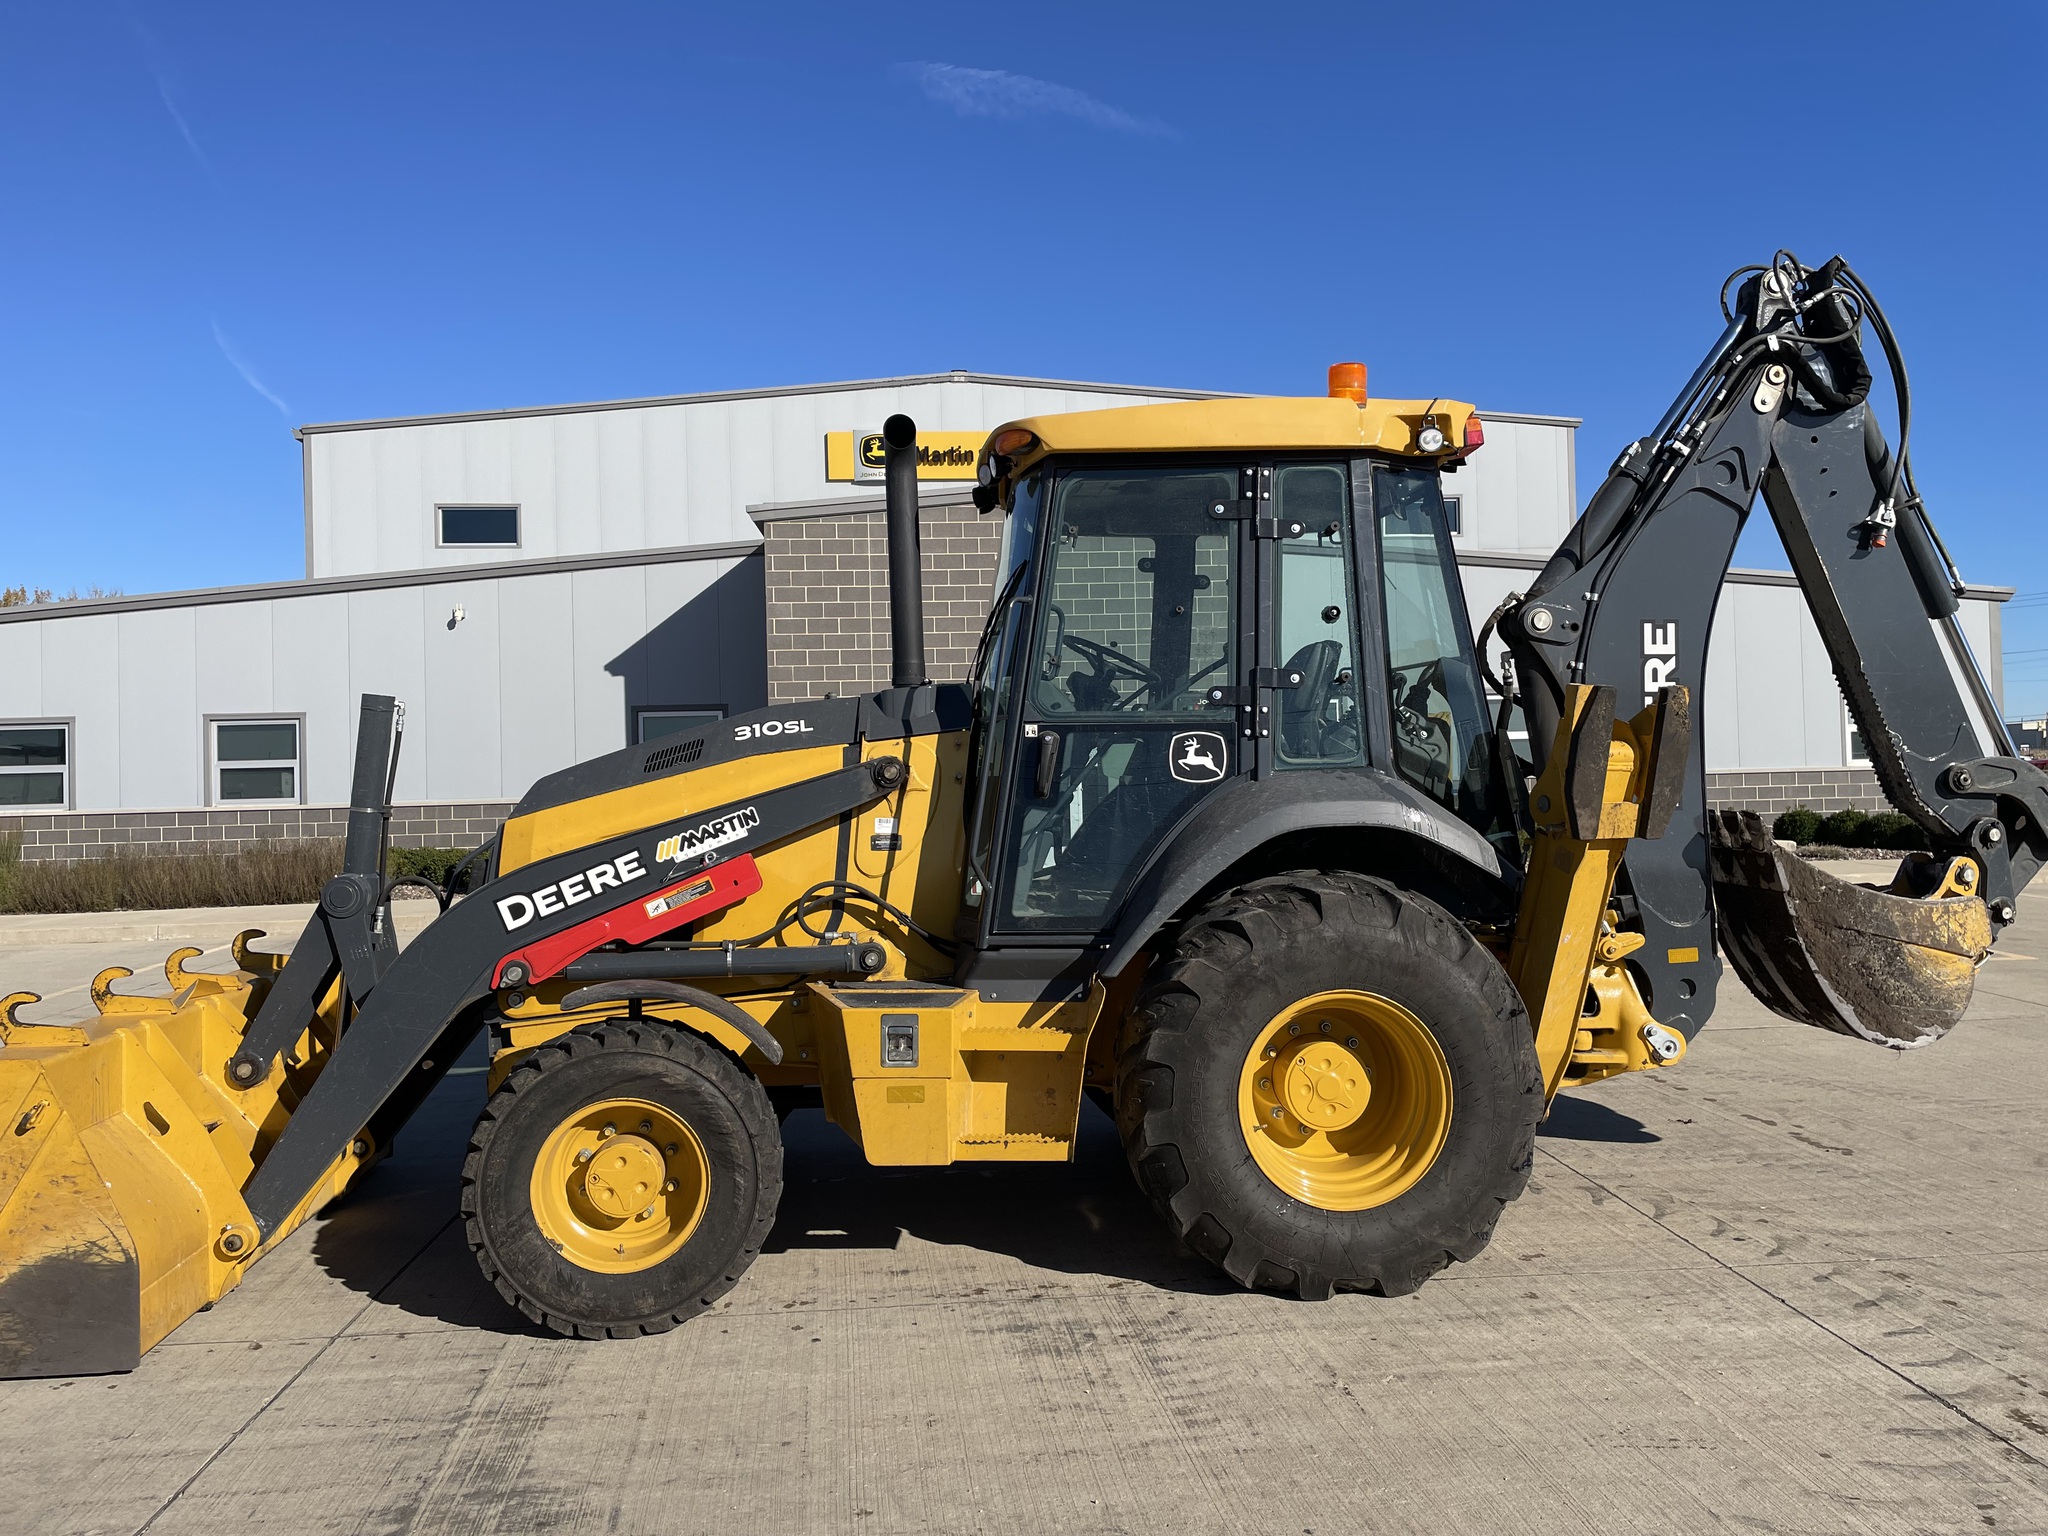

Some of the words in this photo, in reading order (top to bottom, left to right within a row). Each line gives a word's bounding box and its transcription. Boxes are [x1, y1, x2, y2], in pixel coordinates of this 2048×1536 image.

[916, 446, 974, 465] Martin
[734, 720, 814, 741] 310SL
[679, 808, 758, 852] MARTIN
[496, 850, 647, 931] DEERE
